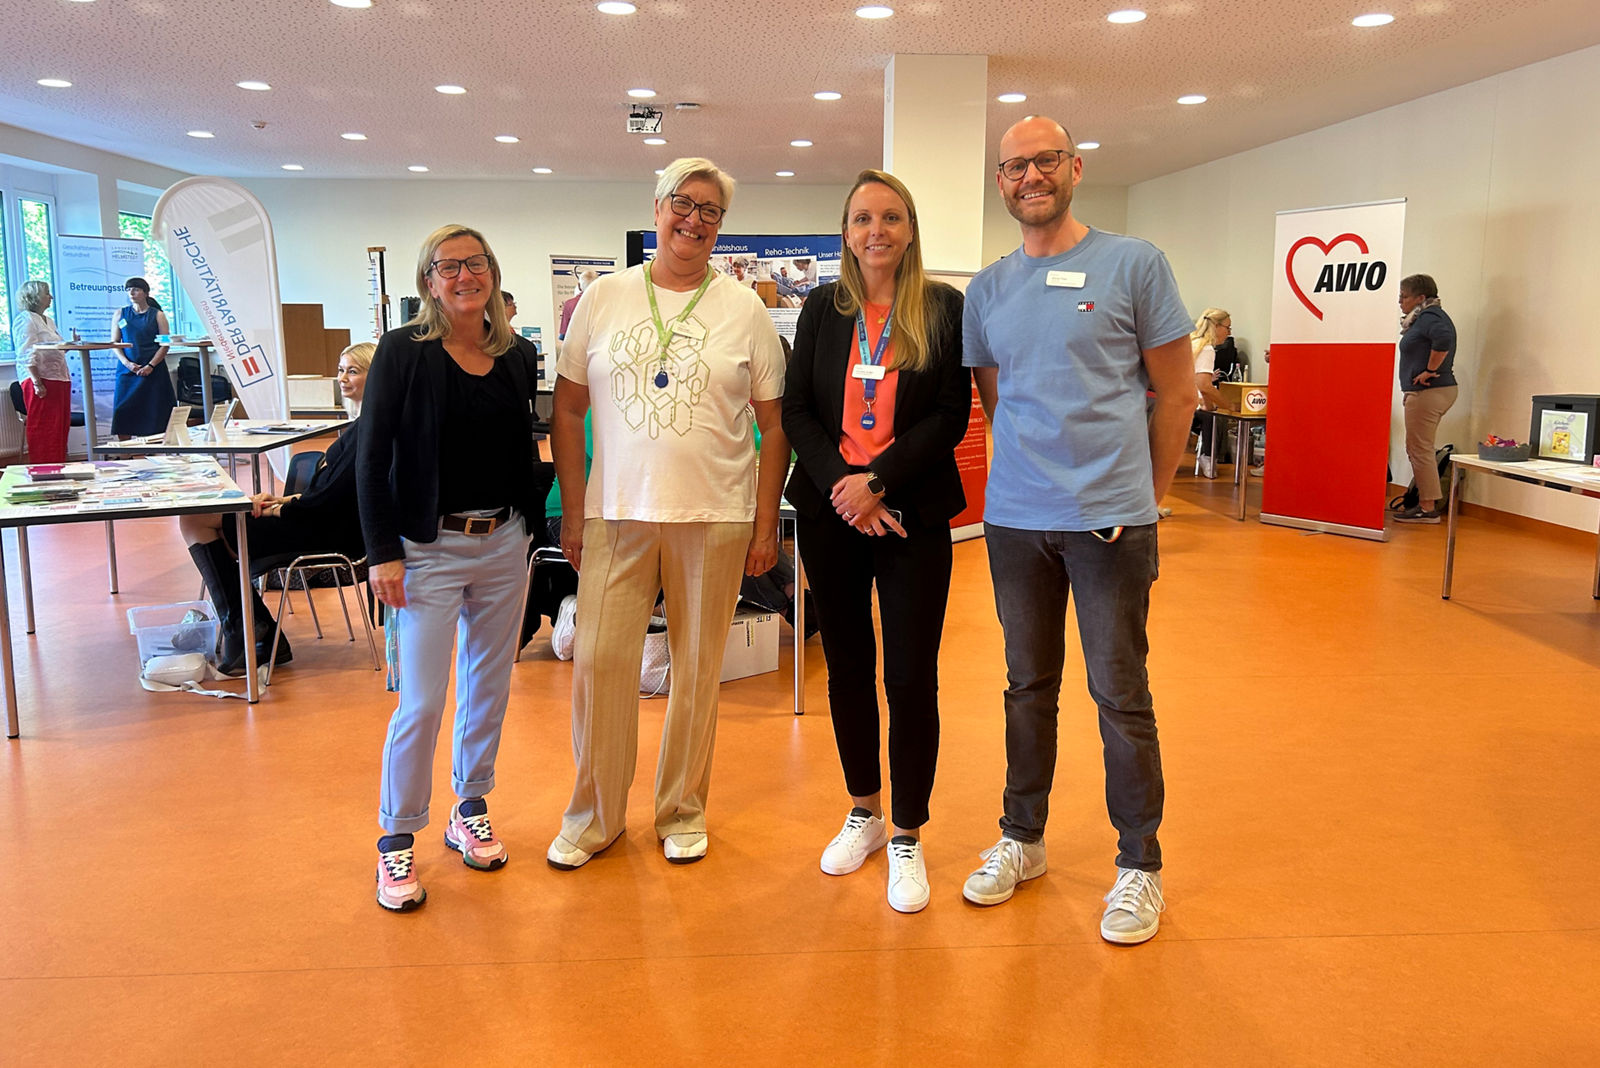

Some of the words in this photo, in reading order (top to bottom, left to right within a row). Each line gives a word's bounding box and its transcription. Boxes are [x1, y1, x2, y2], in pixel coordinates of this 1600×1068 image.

[712, 244, 748, 252] nitätshaus
[765, 246, 809, 256] Reha-Technik
[1313, 261, 1387, 293] AWO
[1252, 397, 1266, 405] AWO
